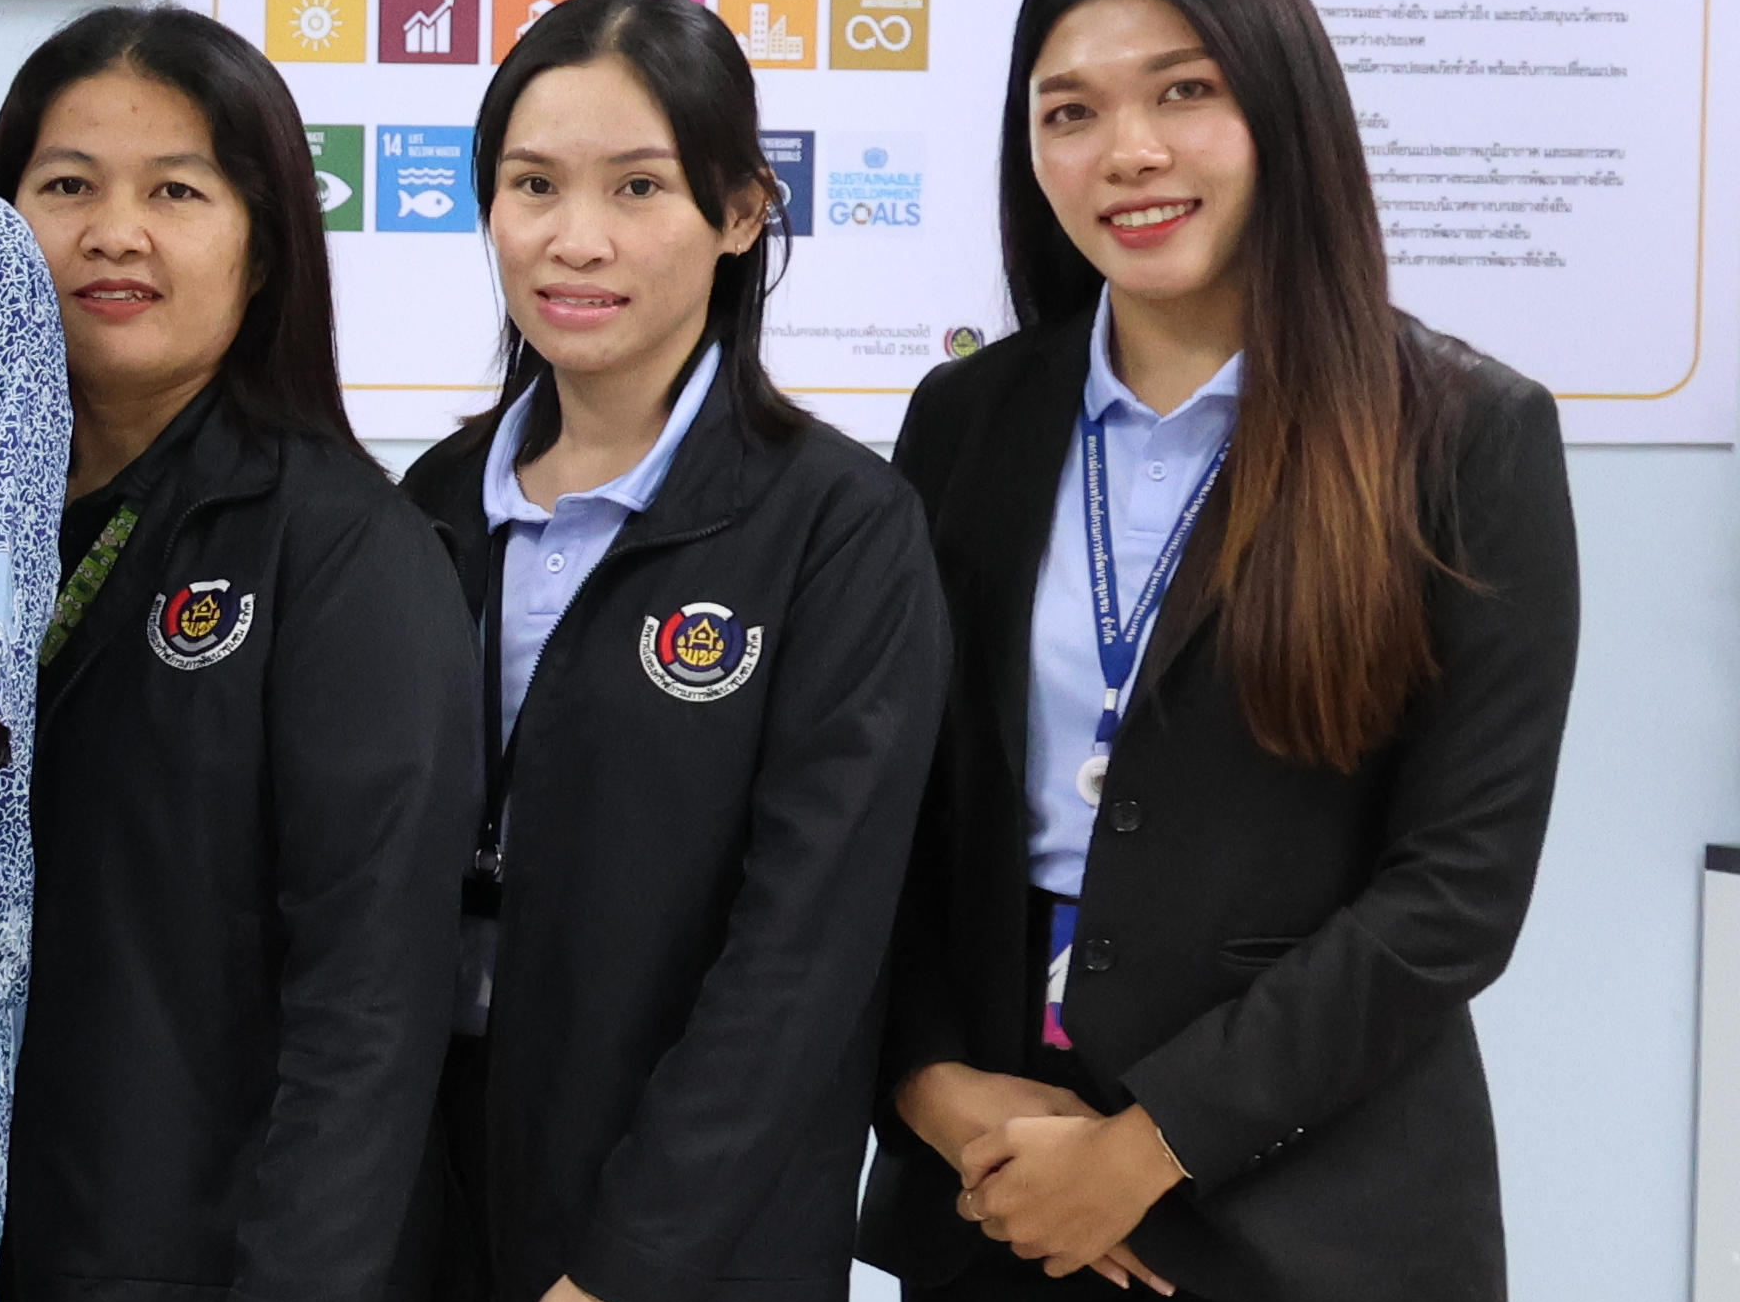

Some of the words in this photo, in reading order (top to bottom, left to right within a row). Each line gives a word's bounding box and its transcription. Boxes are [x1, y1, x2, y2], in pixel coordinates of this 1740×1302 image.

[383, 132, 402, 156] 14
[829, 172, 922, 185] SUSTAINABLE
[829, 188, 922, 199] DEVELOPMENT
[829, 202, 921, 225] GOALS
